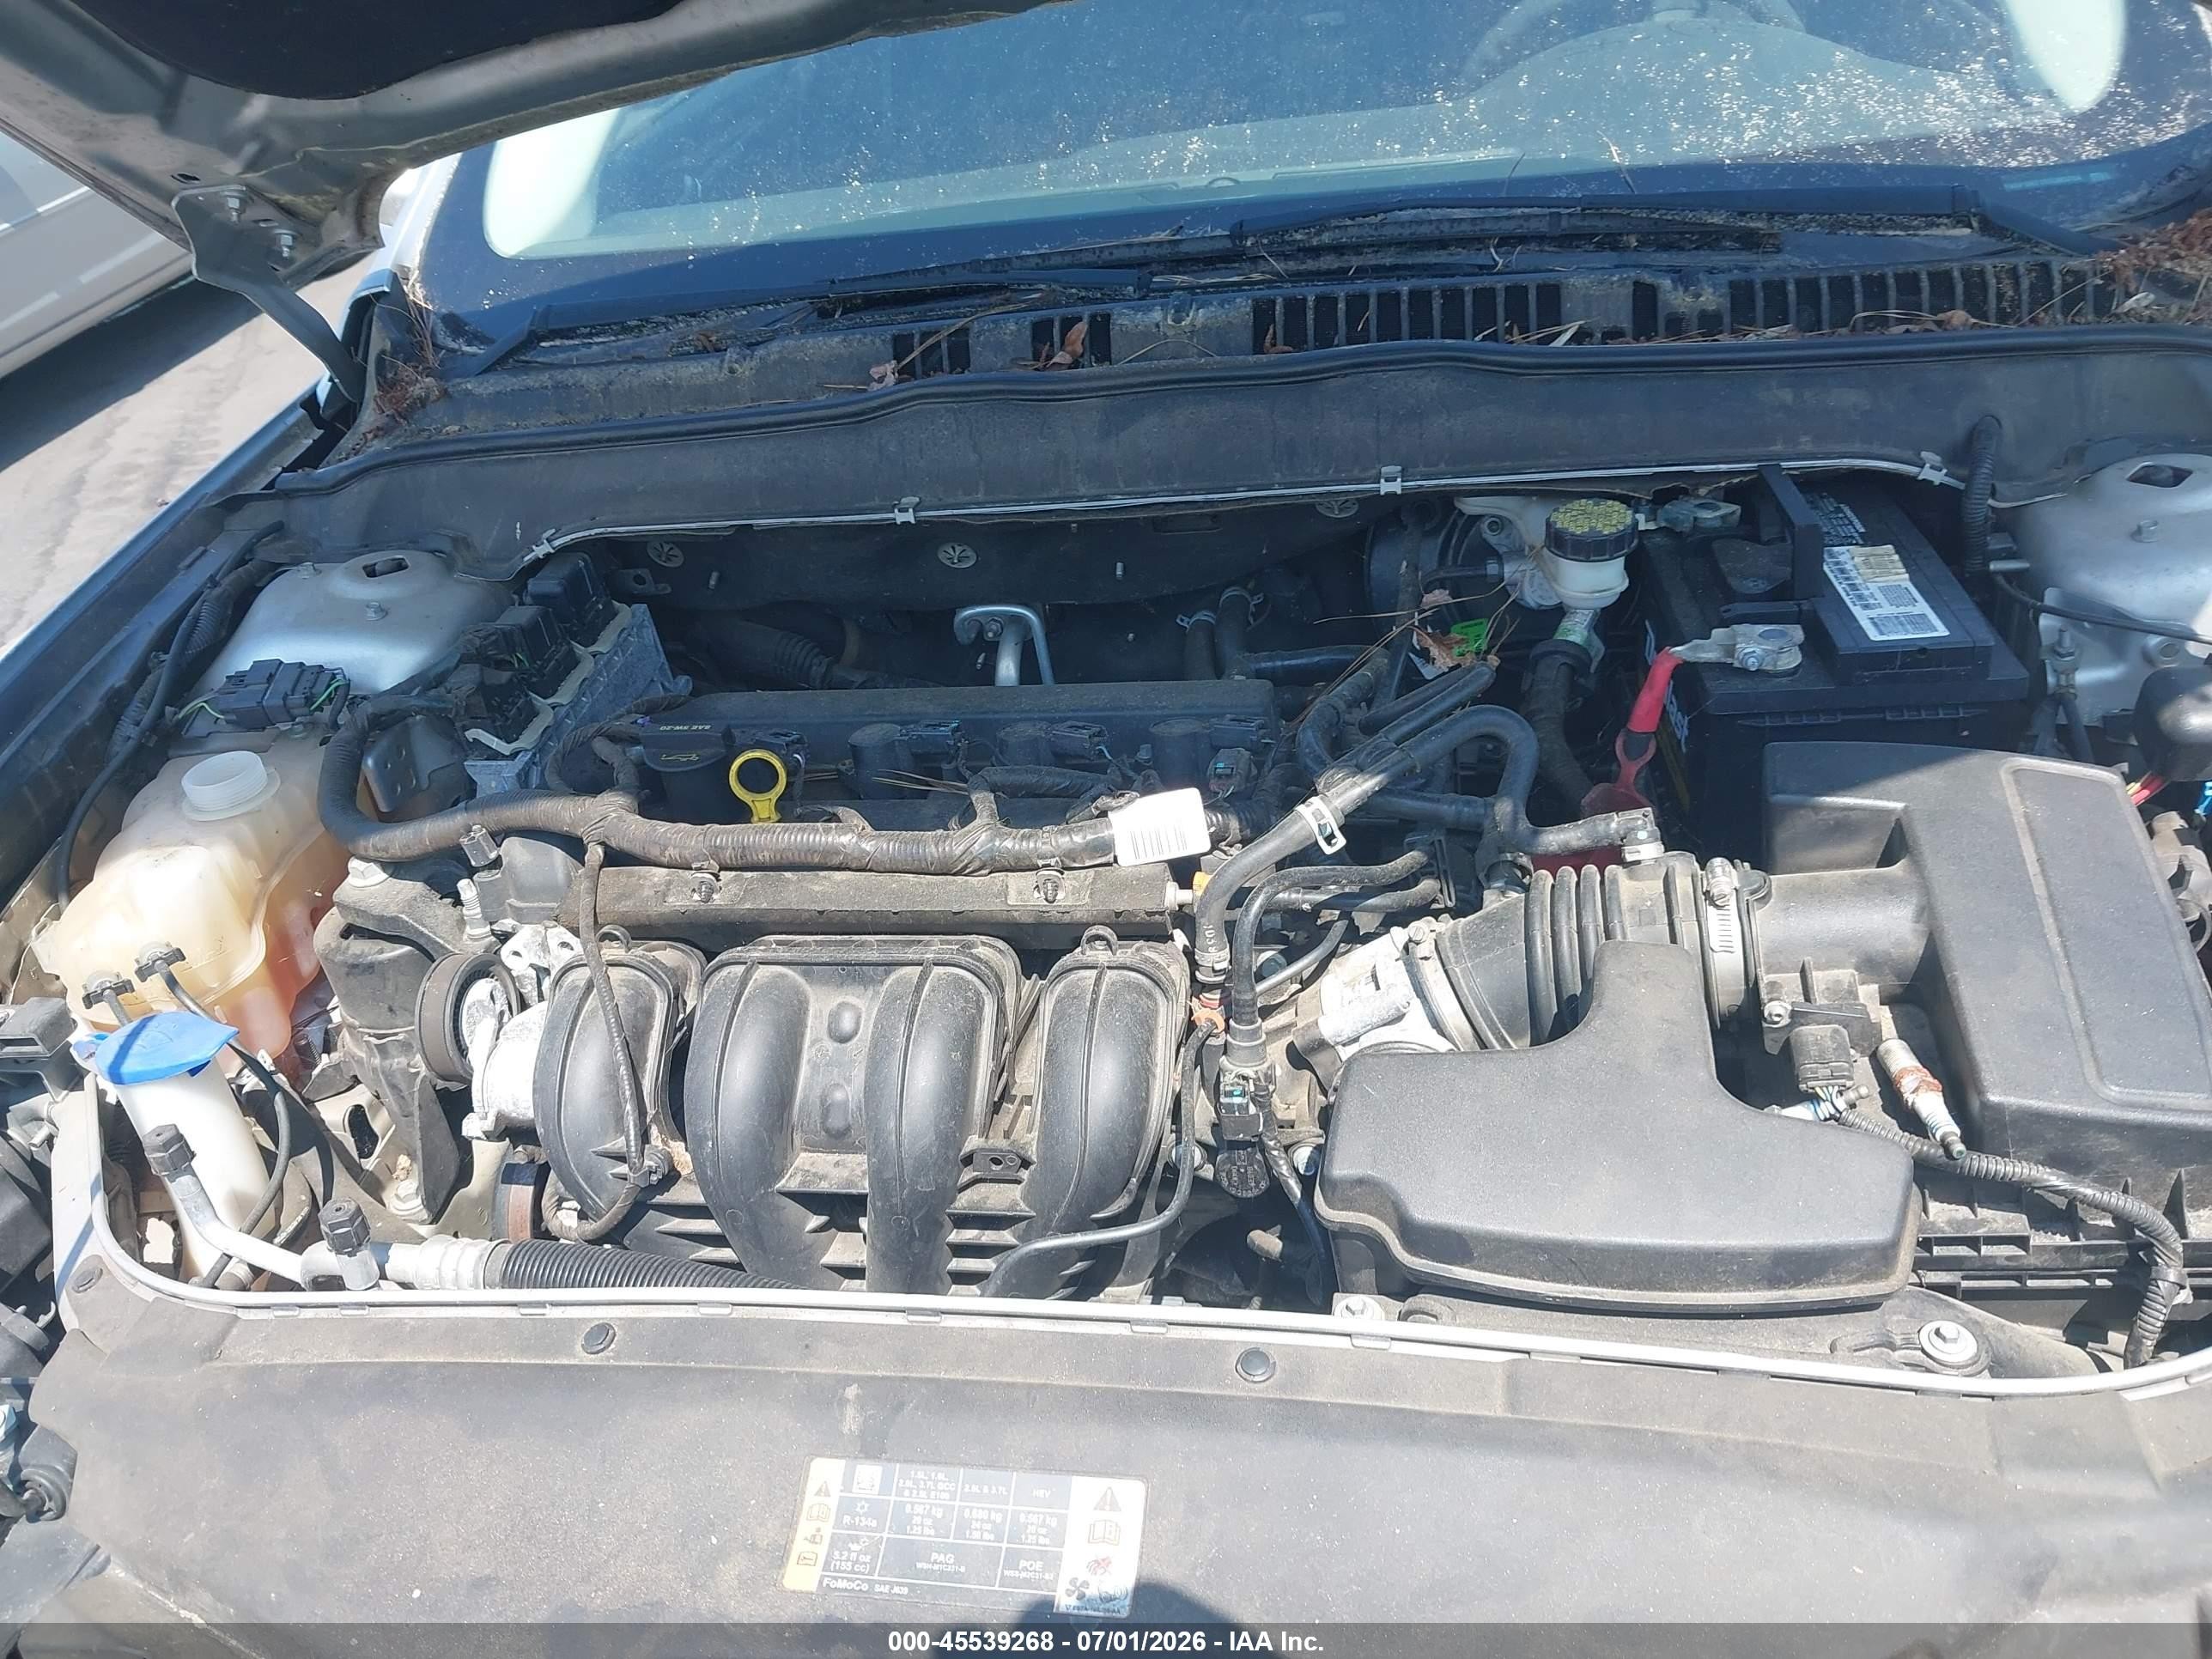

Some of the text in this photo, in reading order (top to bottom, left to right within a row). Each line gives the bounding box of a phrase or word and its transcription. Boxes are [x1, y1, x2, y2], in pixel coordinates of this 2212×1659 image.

[842, 1515, 878, 1528] R-134a
[930, 1552, 955, 1565] PAG
[1018, 1559, 1044, 1572] POE
[823, 1577, 869, 1592] FoMoCo
[874, 1583, 890, 1594] SAE
